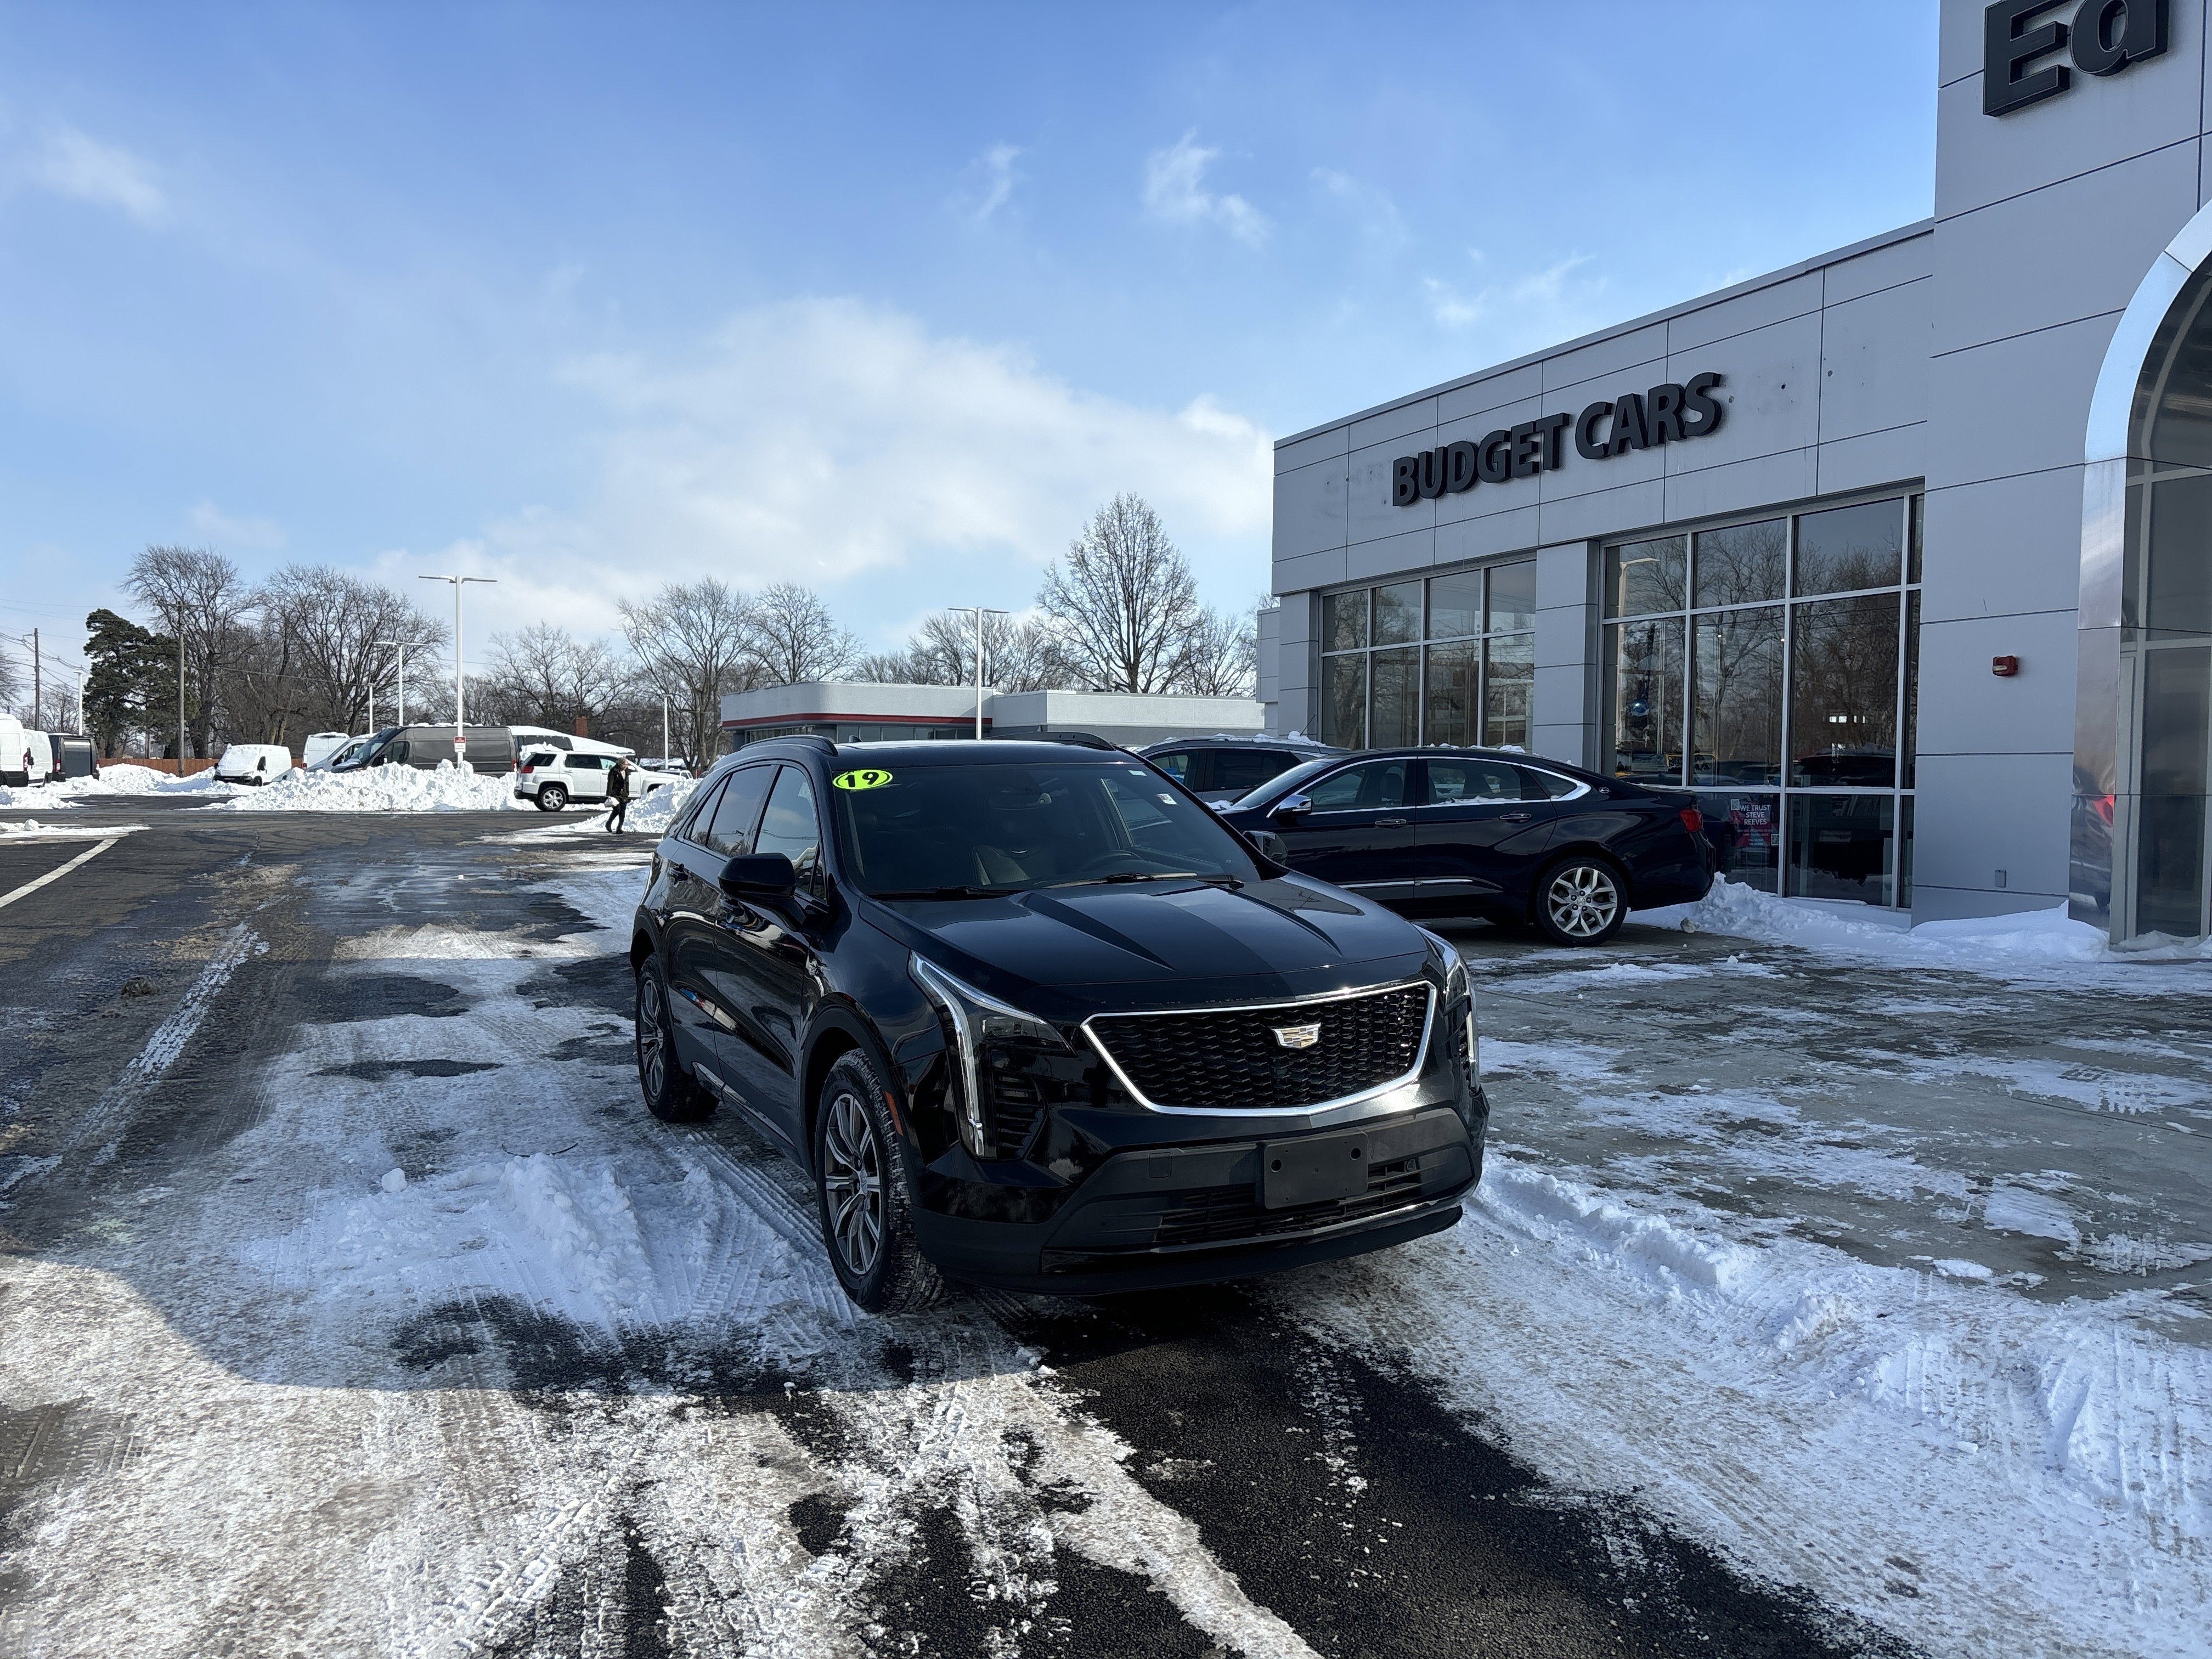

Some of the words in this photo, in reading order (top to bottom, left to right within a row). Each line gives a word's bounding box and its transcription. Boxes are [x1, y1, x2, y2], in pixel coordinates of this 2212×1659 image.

[1392, 412, 1570, 507] BUDGET
[1575, 371, 1723, 460] CARS
[844, 771, 879, 788] 19
